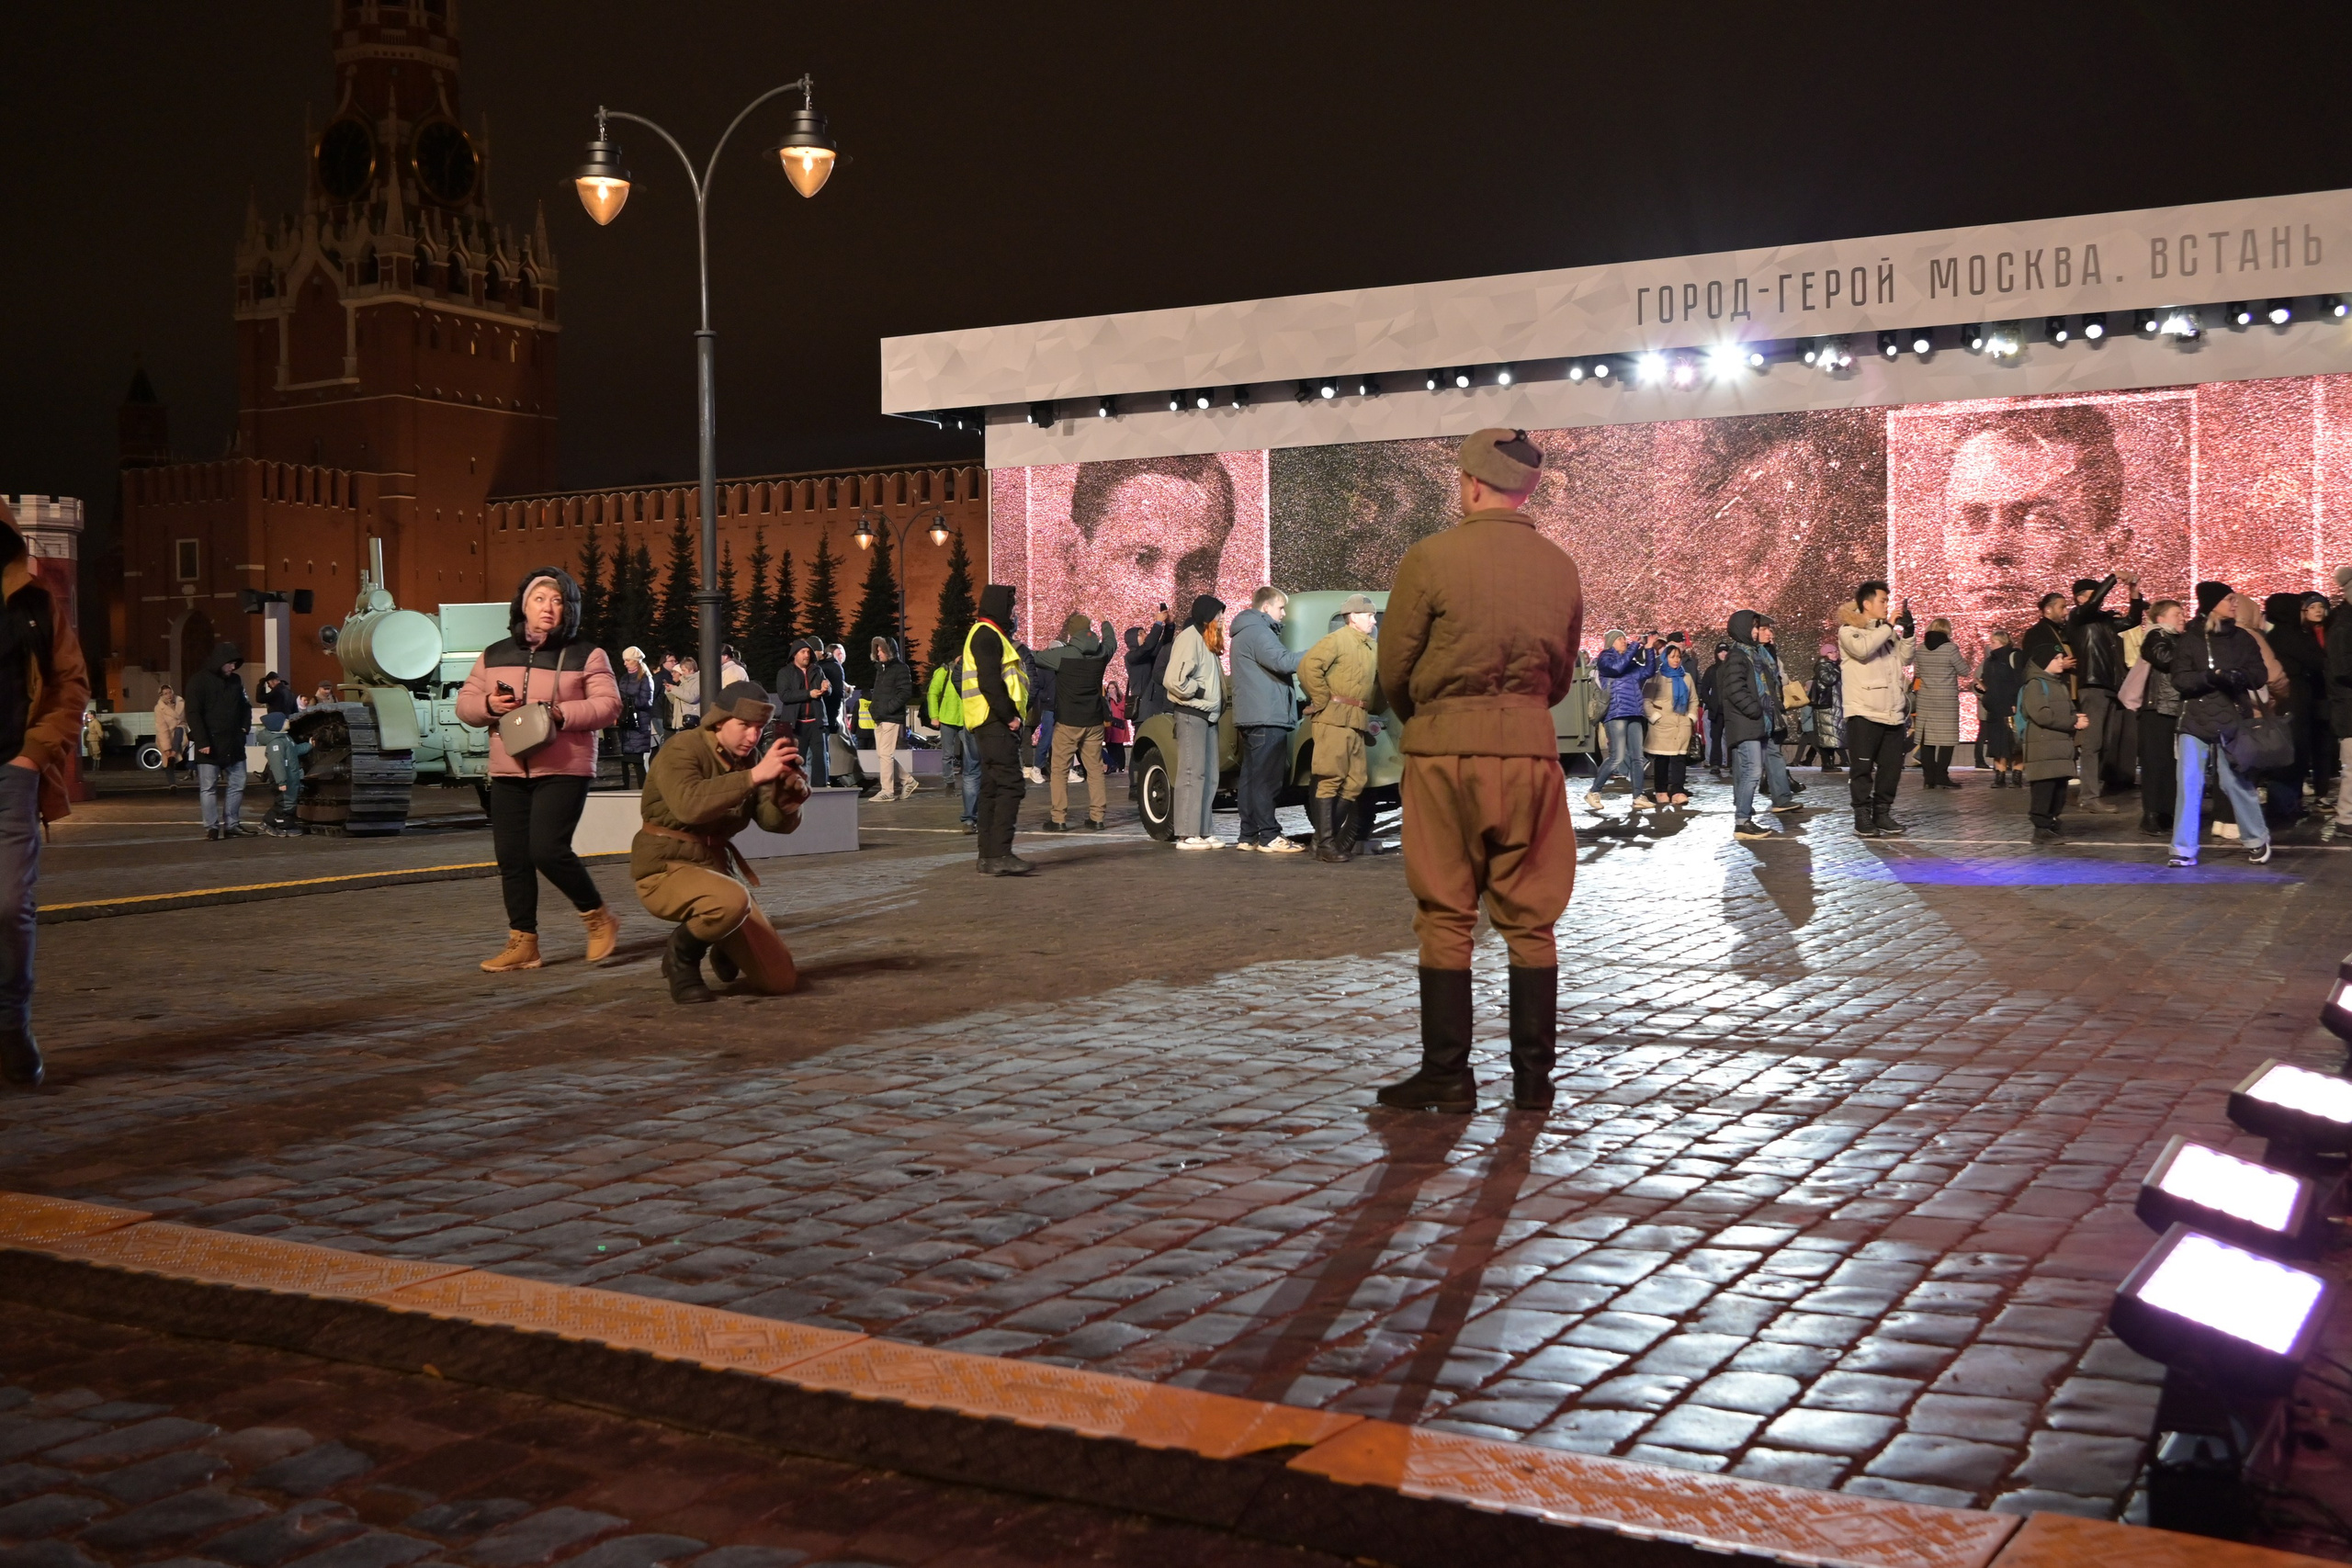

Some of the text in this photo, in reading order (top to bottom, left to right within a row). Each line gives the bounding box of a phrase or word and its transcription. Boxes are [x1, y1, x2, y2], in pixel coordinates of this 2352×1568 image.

[1637, 223, 2322, 326] ГОРОД-ГЕРОЙ МОСКВА. ВСТАНЬ
